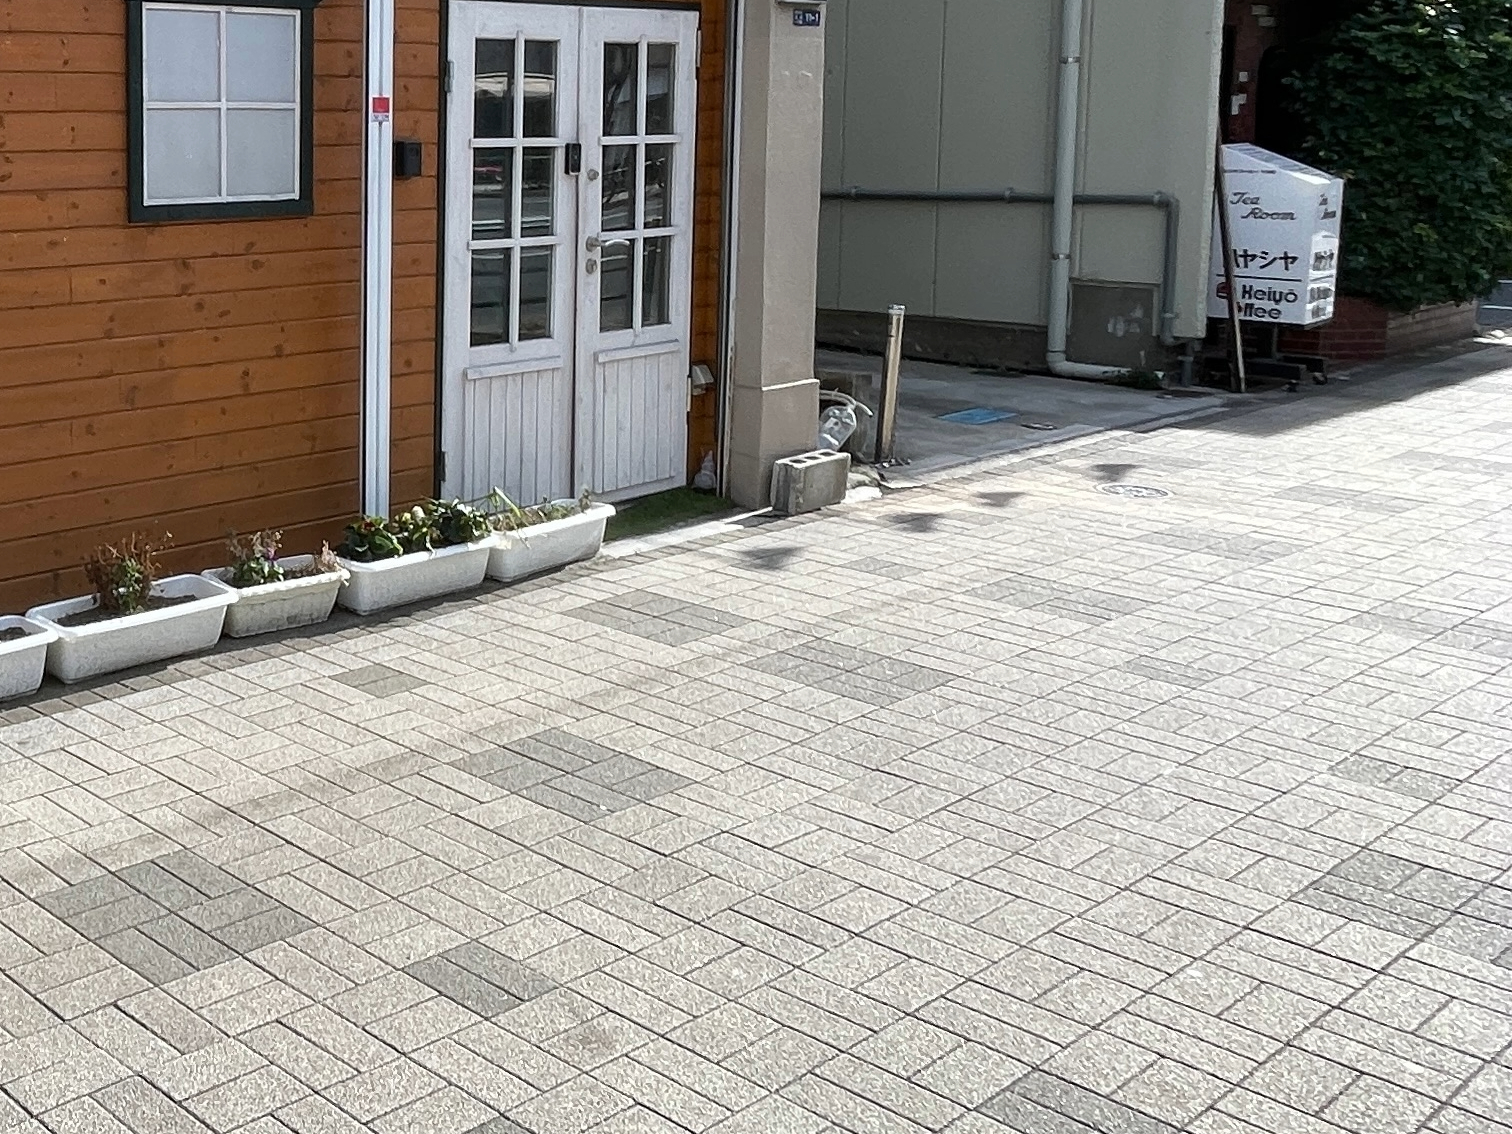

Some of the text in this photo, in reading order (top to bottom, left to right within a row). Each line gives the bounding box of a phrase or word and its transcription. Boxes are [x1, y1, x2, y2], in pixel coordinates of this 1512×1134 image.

[1230, 192, 1260, 205] Tea
[1241, 207, 1296, 220] Room
[1236, 302, 1283, 320] ffee
